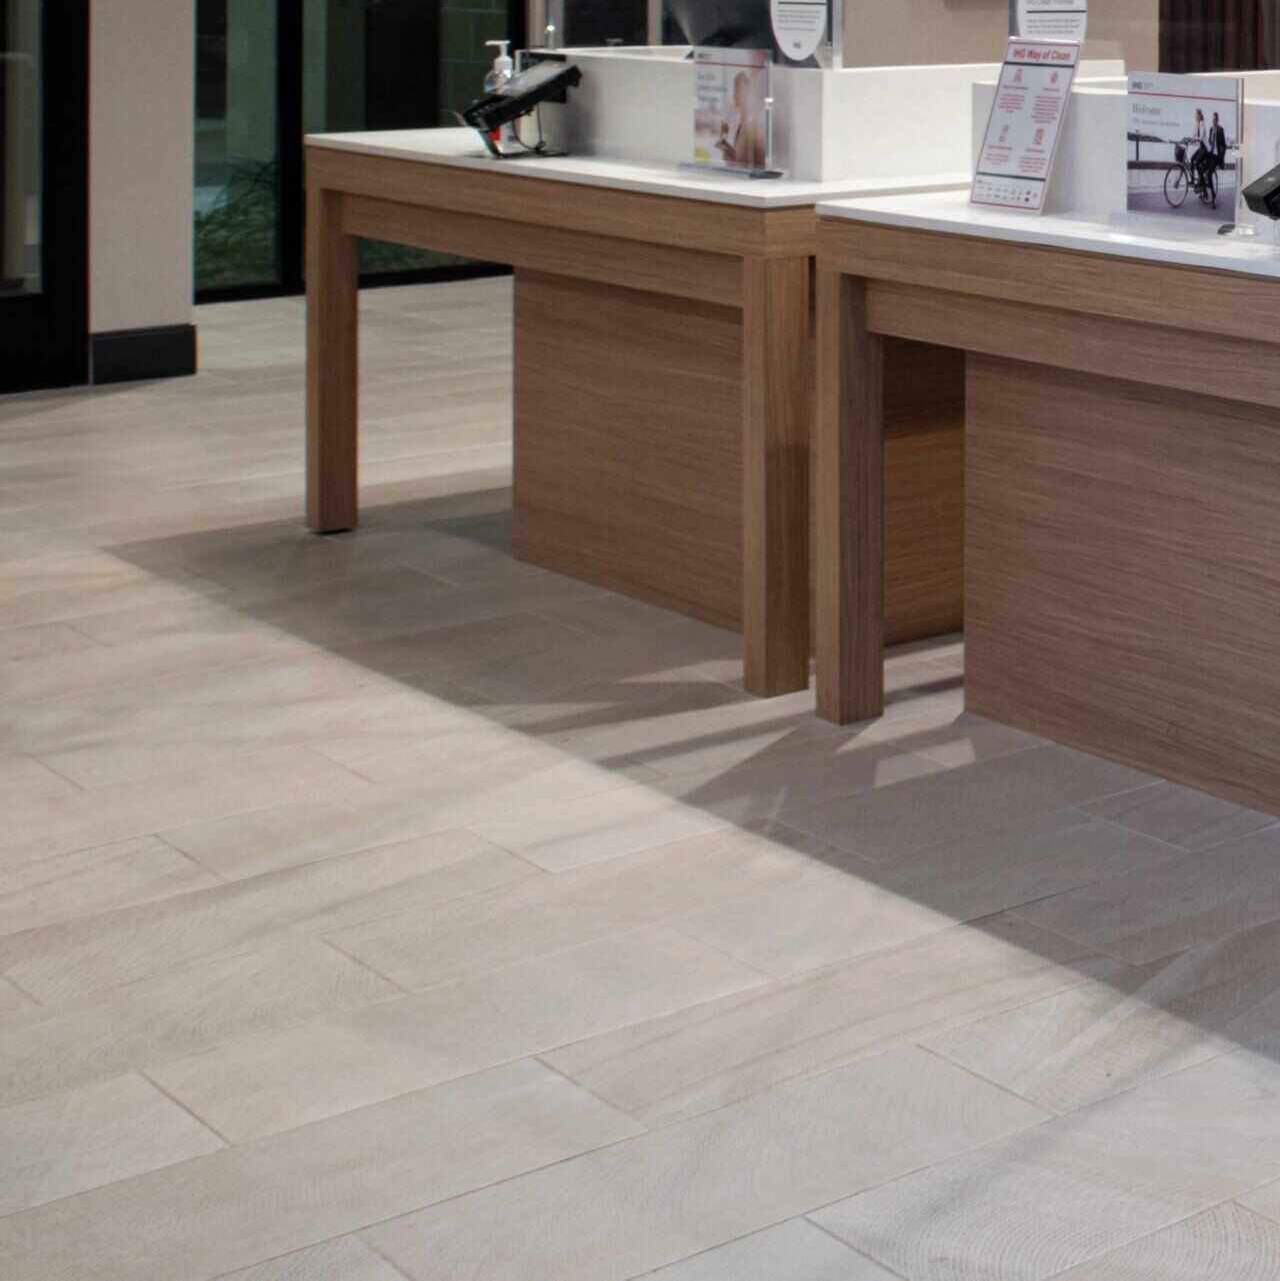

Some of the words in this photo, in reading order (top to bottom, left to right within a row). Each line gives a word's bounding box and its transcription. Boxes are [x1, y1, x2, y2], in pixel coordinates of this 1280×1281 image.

[1013, 48, 1026, 59] IHG
[1027, 49, 1041, 62] Way
[1042, 50, 1050, 60] of
[1051, 50, 1070, 61] Clean
[1132, 102, 1162, 116] Welcome
